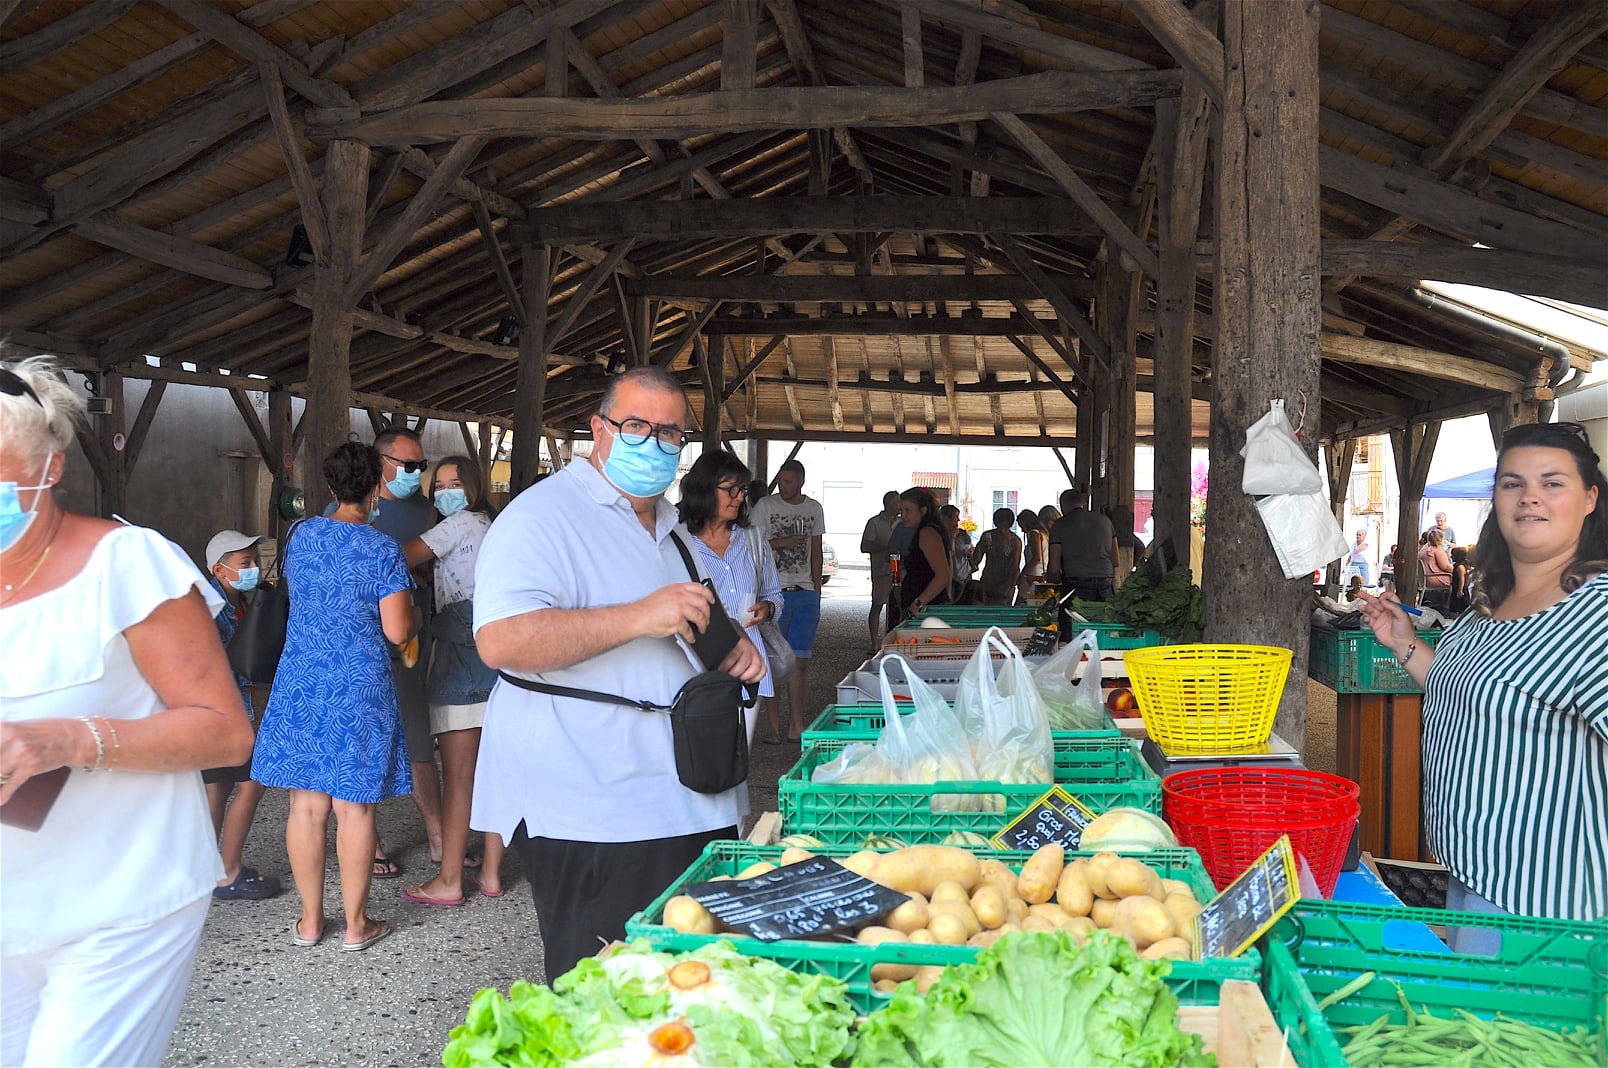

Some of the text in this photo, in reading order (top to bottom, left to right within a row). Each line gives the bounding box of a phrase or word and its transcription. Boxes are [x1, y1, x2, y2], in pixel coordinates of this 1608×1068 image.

[1015, 829, 1040, 849] 2,50
[1039, 809, 1081, 847] Gros Me
